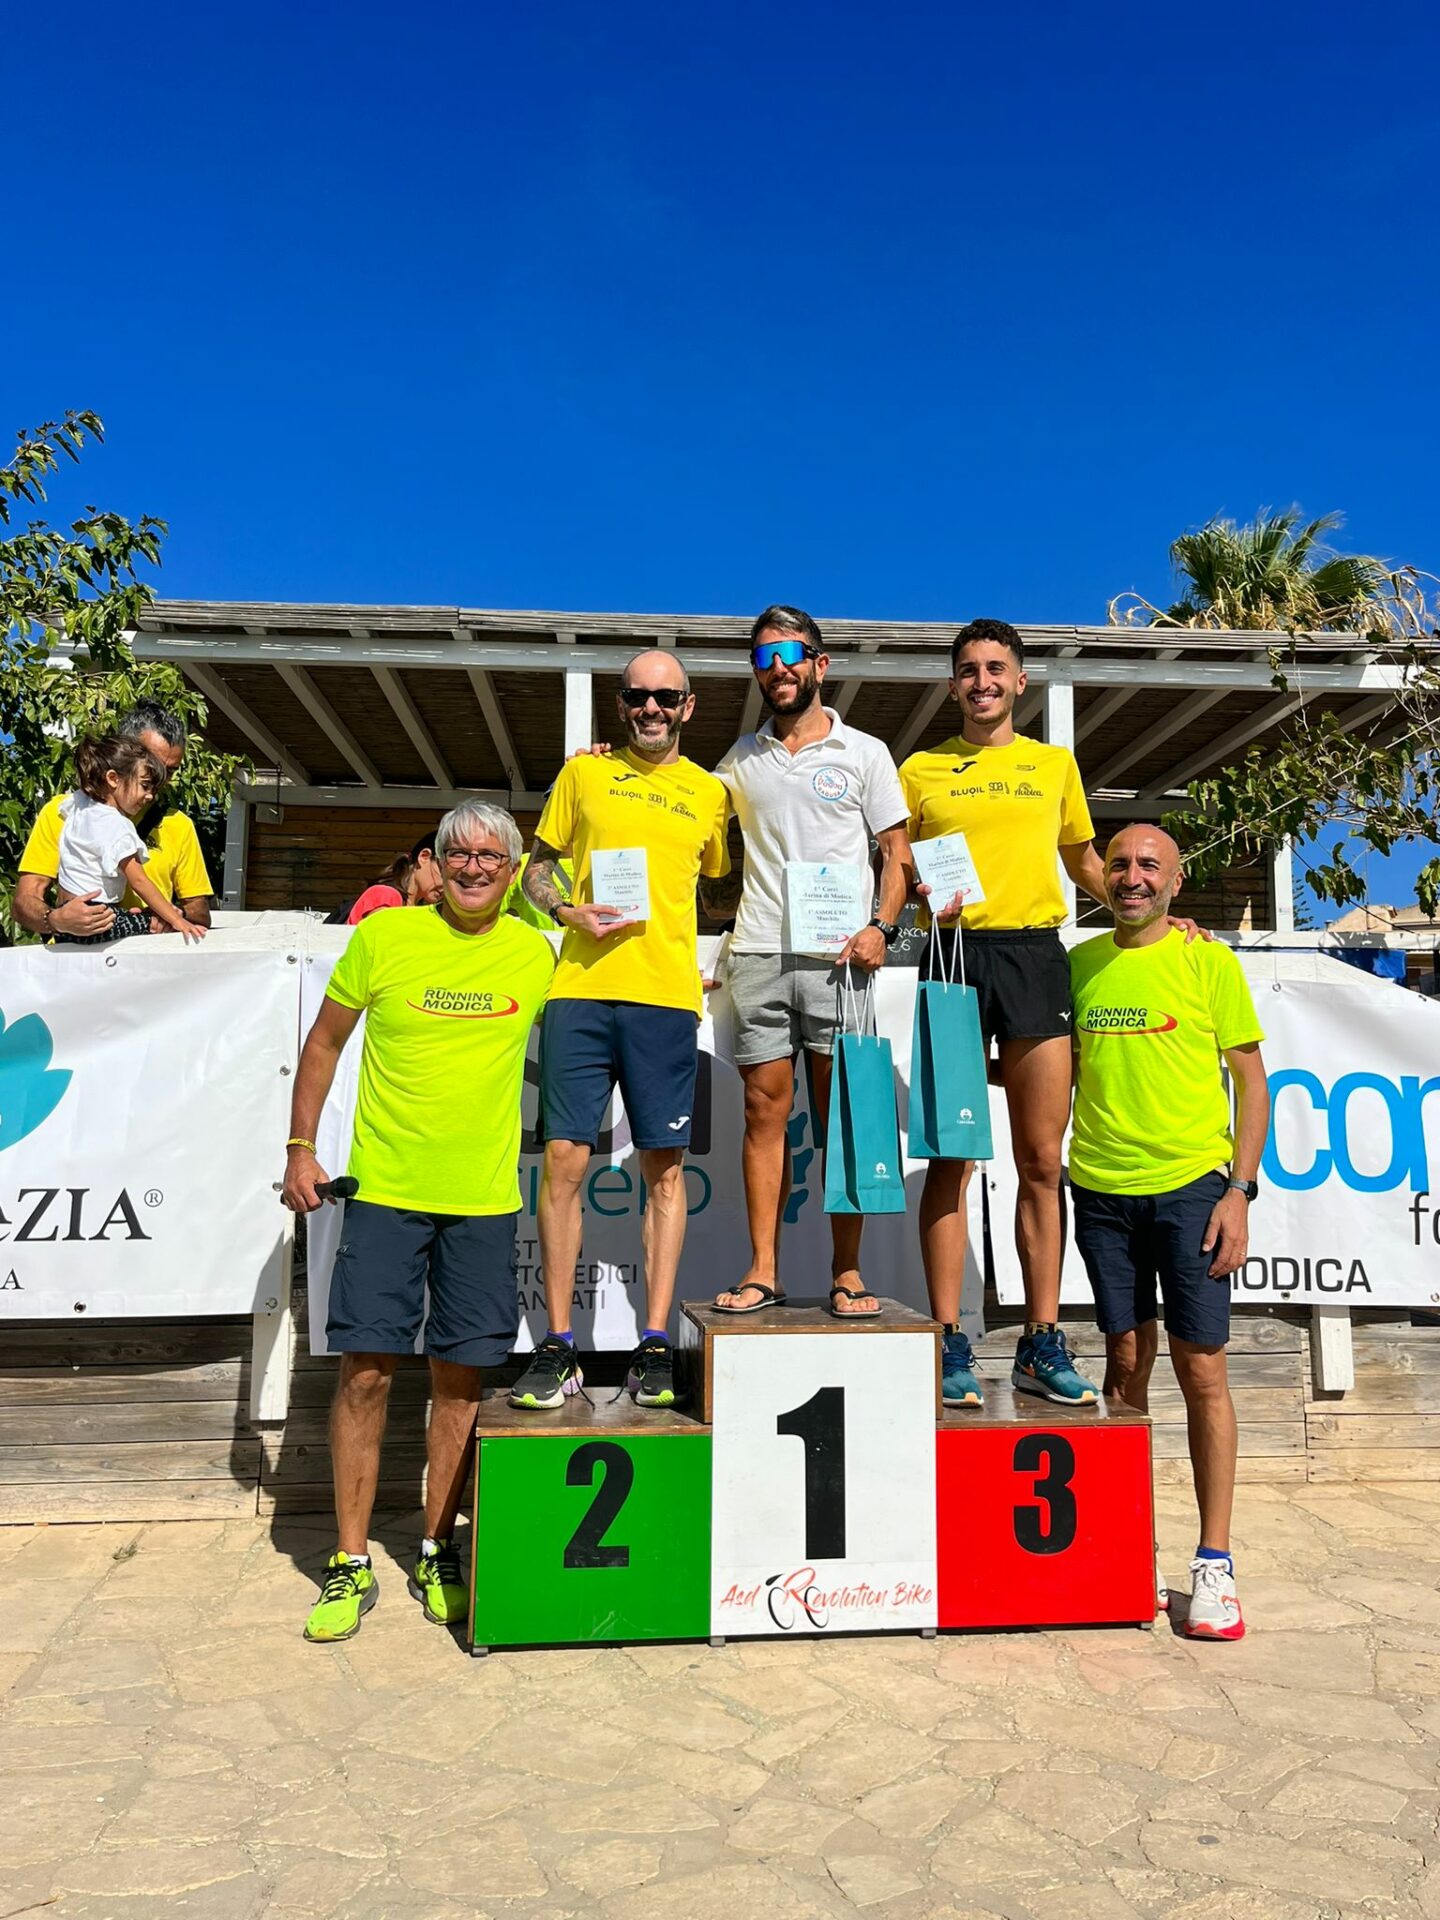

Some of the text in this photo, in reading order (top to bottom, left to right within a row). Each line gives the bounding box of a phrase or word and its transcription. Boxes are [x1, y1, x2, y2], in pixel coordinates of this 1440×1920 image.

[423, 999, 493, 1011] MODICA
[424, 989, 493, 1001] RUNNING
[1087, 1008, 1148, 1019] RUNNING
[1087, 1018, 1146, 1028] MODICA
[777, 1386, 846, 1560] 1
[563, 1440, 635, 1569] 2
[1012, 1433, 1078, 1555] 3
[720, 1567, 933, 1613] Asd Revolution Bike
